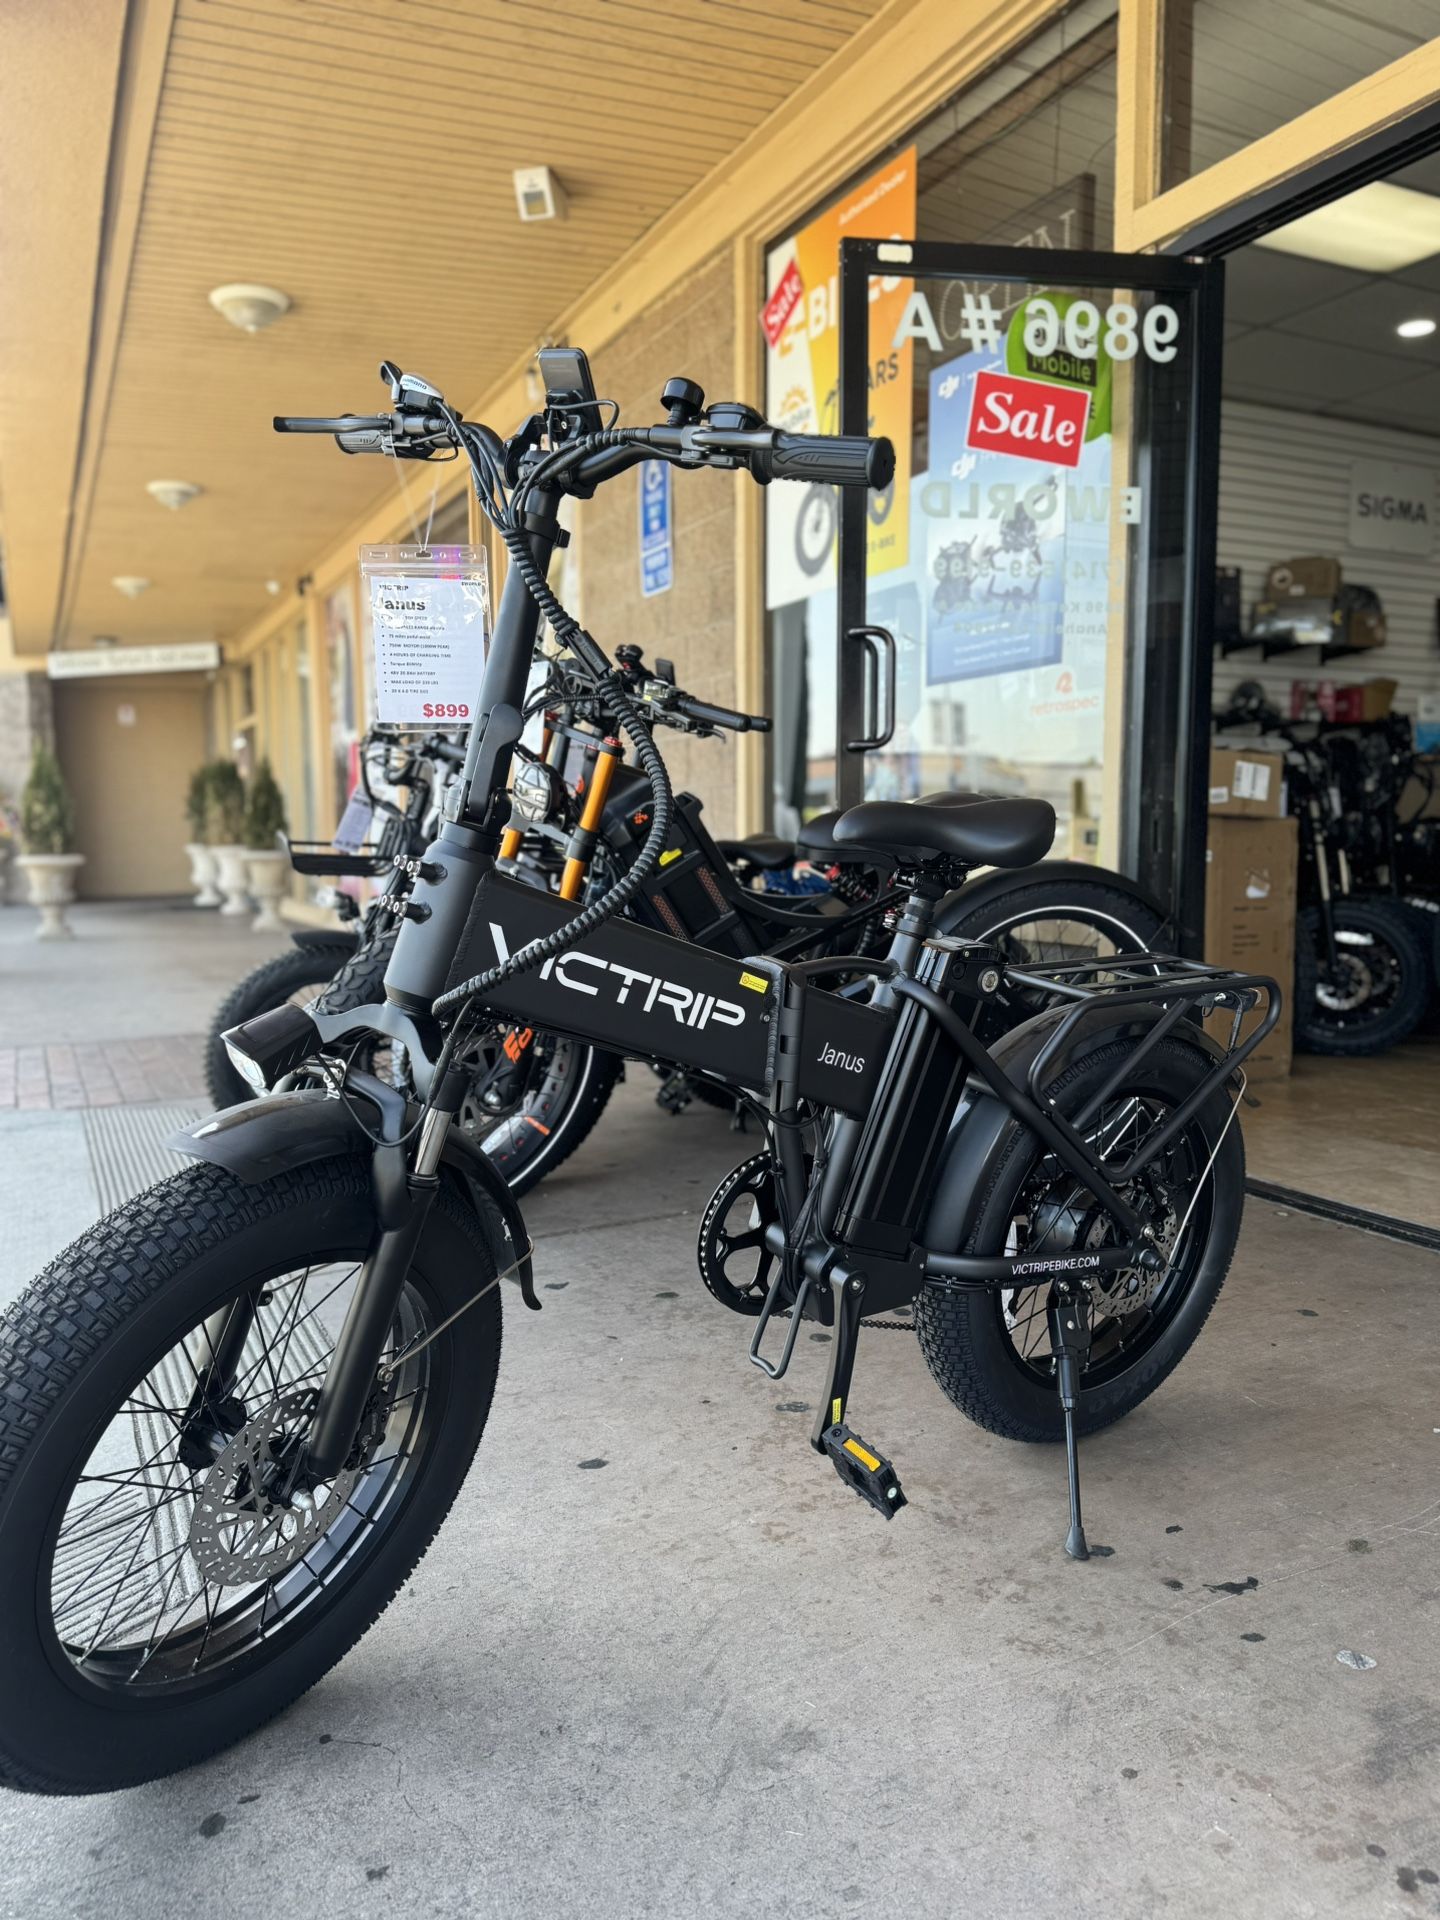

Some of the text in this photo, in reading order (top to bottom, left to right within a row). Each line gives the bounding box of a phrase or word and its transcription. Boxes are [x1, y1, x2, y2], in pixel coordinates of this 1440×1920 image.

[977, 391, 1076, 447] Sale
[1357, 492, 1429, 525] SIGMA
[423, 703, 469, 719] $899
[817, 1041, 866, 1074] Janus
[1011, 1256, 1100, 1276] VICTRIPEBIKE.COM
